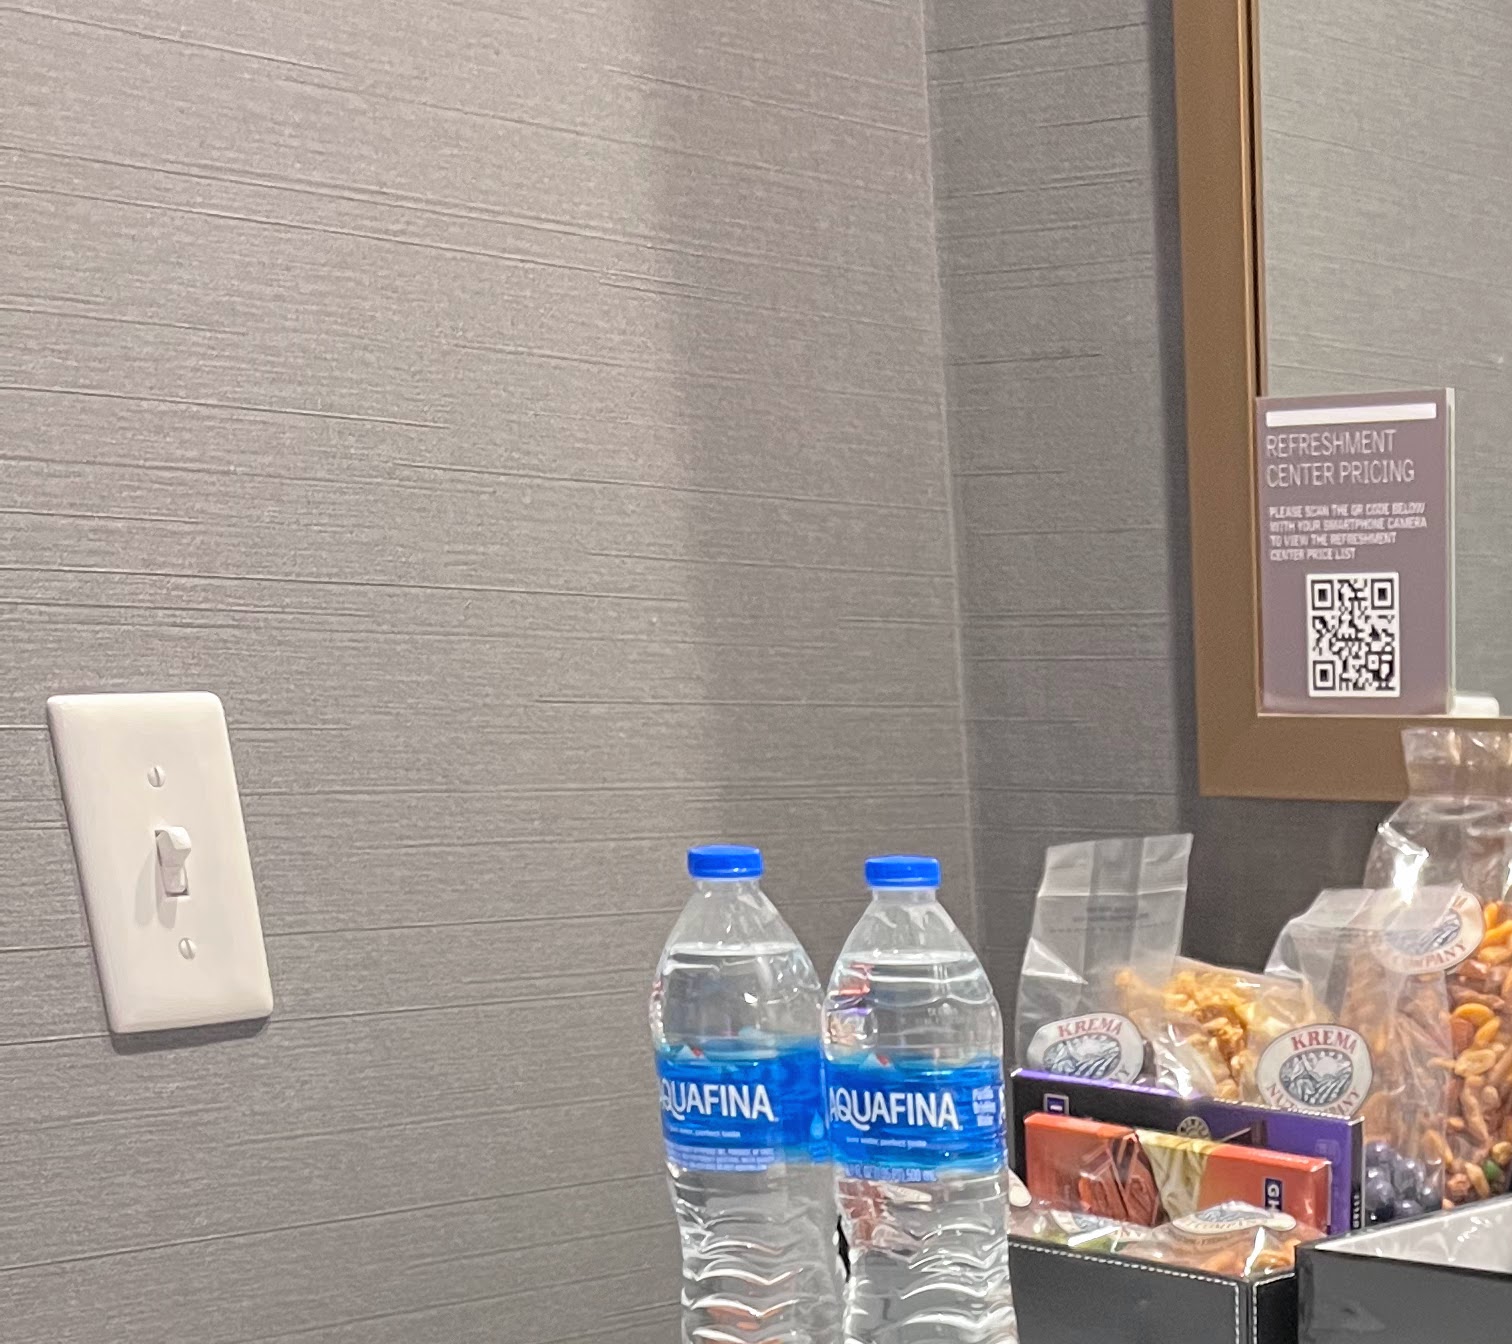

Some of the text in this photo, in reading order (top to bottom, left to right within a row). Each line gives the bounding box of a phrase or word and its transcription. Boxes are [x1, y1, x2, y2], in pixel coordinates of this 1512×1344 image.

[1265, 430, 1397, 457] REFRESHMENT
[1266, 458, 1415, 488] CENTER PRICING
[1269, 505, 1303, 518] PLEASE
[1304, 505, 1330, 517] SCAN
[1331, 503, 1349, 517] THE
[1365, 503, 1390, 516] CODE
[1391, 502, 1426, 515] BELOW
[1269, 516, 1427, 532] WITH YOUR SMARTPHONE CAMERA
[1270, 531, 1397, 547] TO VIEW THE REFRESHMENT
[1270, 547, 1356, 561] CENTER PRICE LIST
[1057, 1017, 1122, 1038] KREMA
[1291, 1030, 1357, 1055] KREMA
[660, 1077, 775, 1121] QUAFINA
[829, 1086, 960, 1131] AQUAFINA
